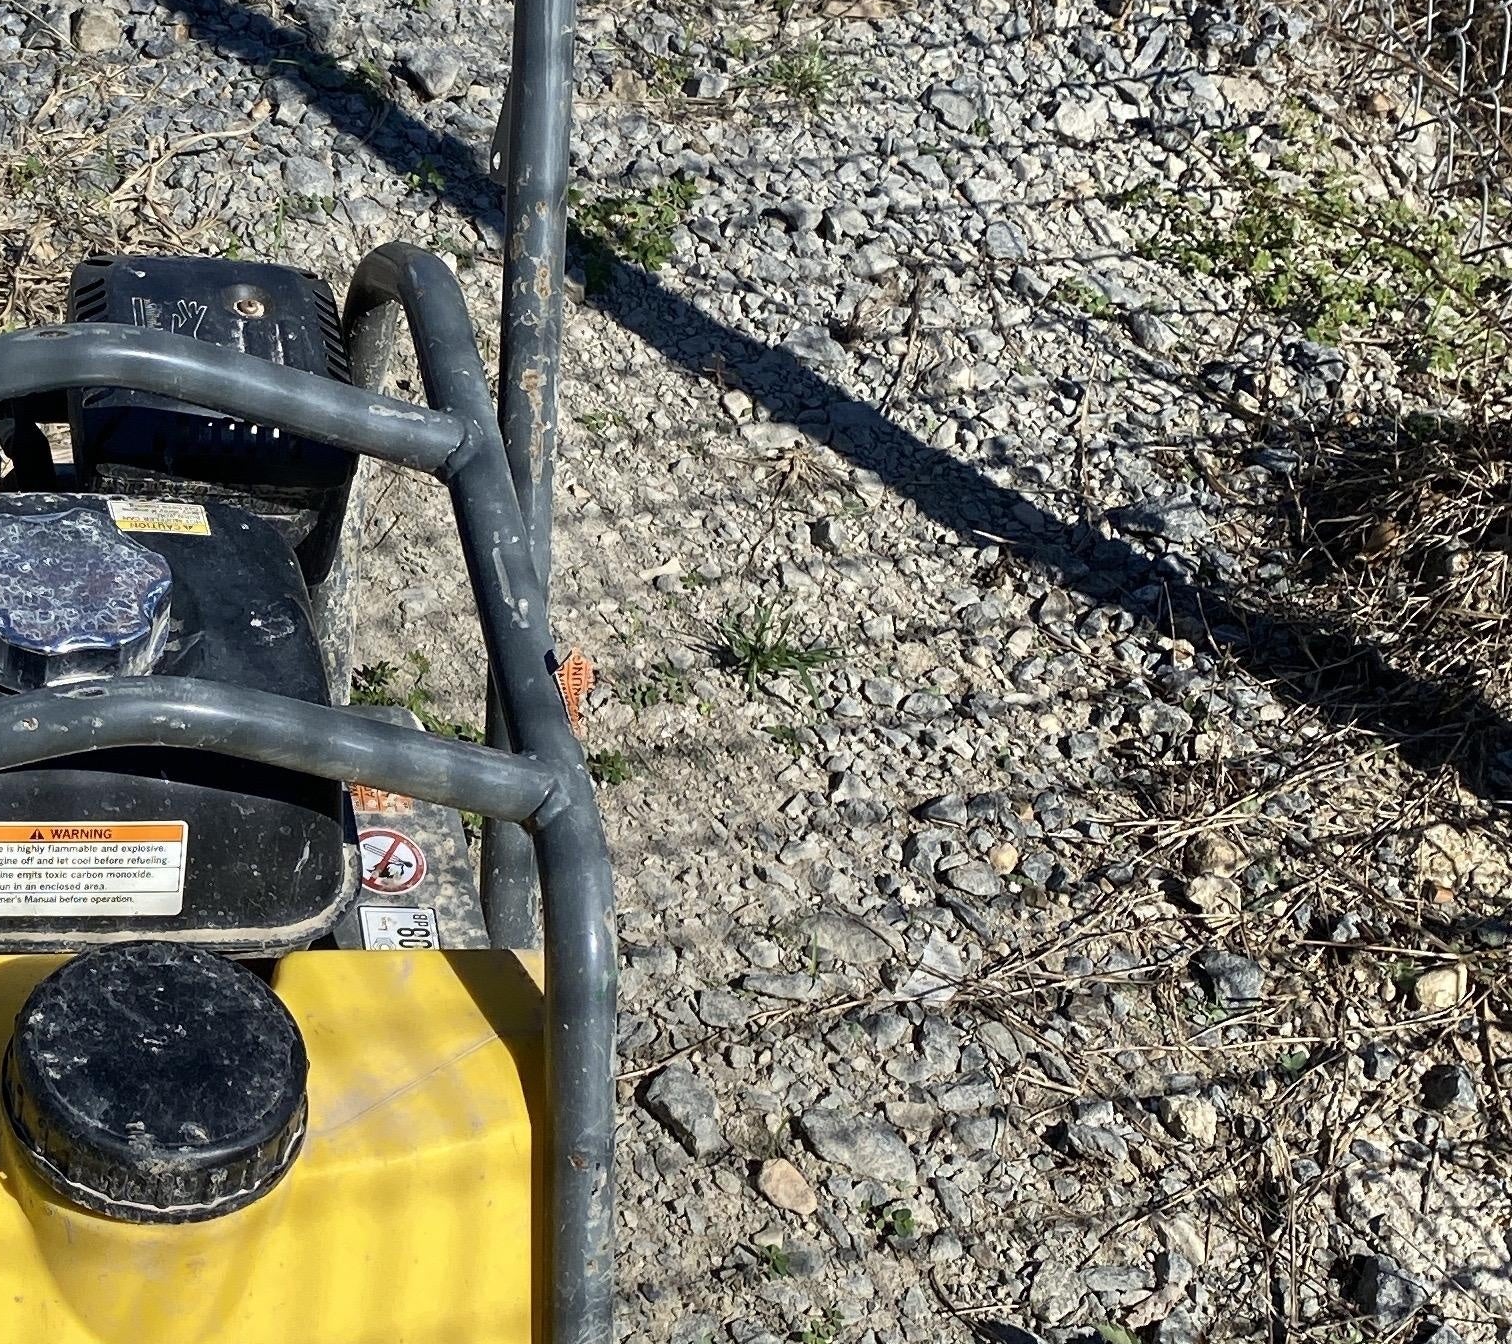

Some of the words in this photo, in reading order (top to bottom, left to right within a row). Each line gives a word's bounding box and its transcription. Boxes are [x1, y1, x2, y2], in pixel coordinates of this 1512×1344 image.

[50, 828, 113, 840] WARNING
[6, 844, 14, 853] is
[16, 844, 45, 855] highly
[47, 844, 98, 853] flammable
[100, 844, 119, 853] and
[20, 856, 34, 865] off
[36, 856, 55, 865] and
[56, 856, 69, 865] let
[71, 856, 92, 865] cool
[94, 856, 125, 865] before
[16, 870, 43, 880] emits
[45, 870, 68, 879] toxic
[70, 870, 104, 879] carbon
[13, 882, 23, 891] in
[25, 883, 37, 891] an
[39, 882, 81, 891] enclosed
[24, 895, 57, 904] Manual
[59, 895, 89, 904] before
